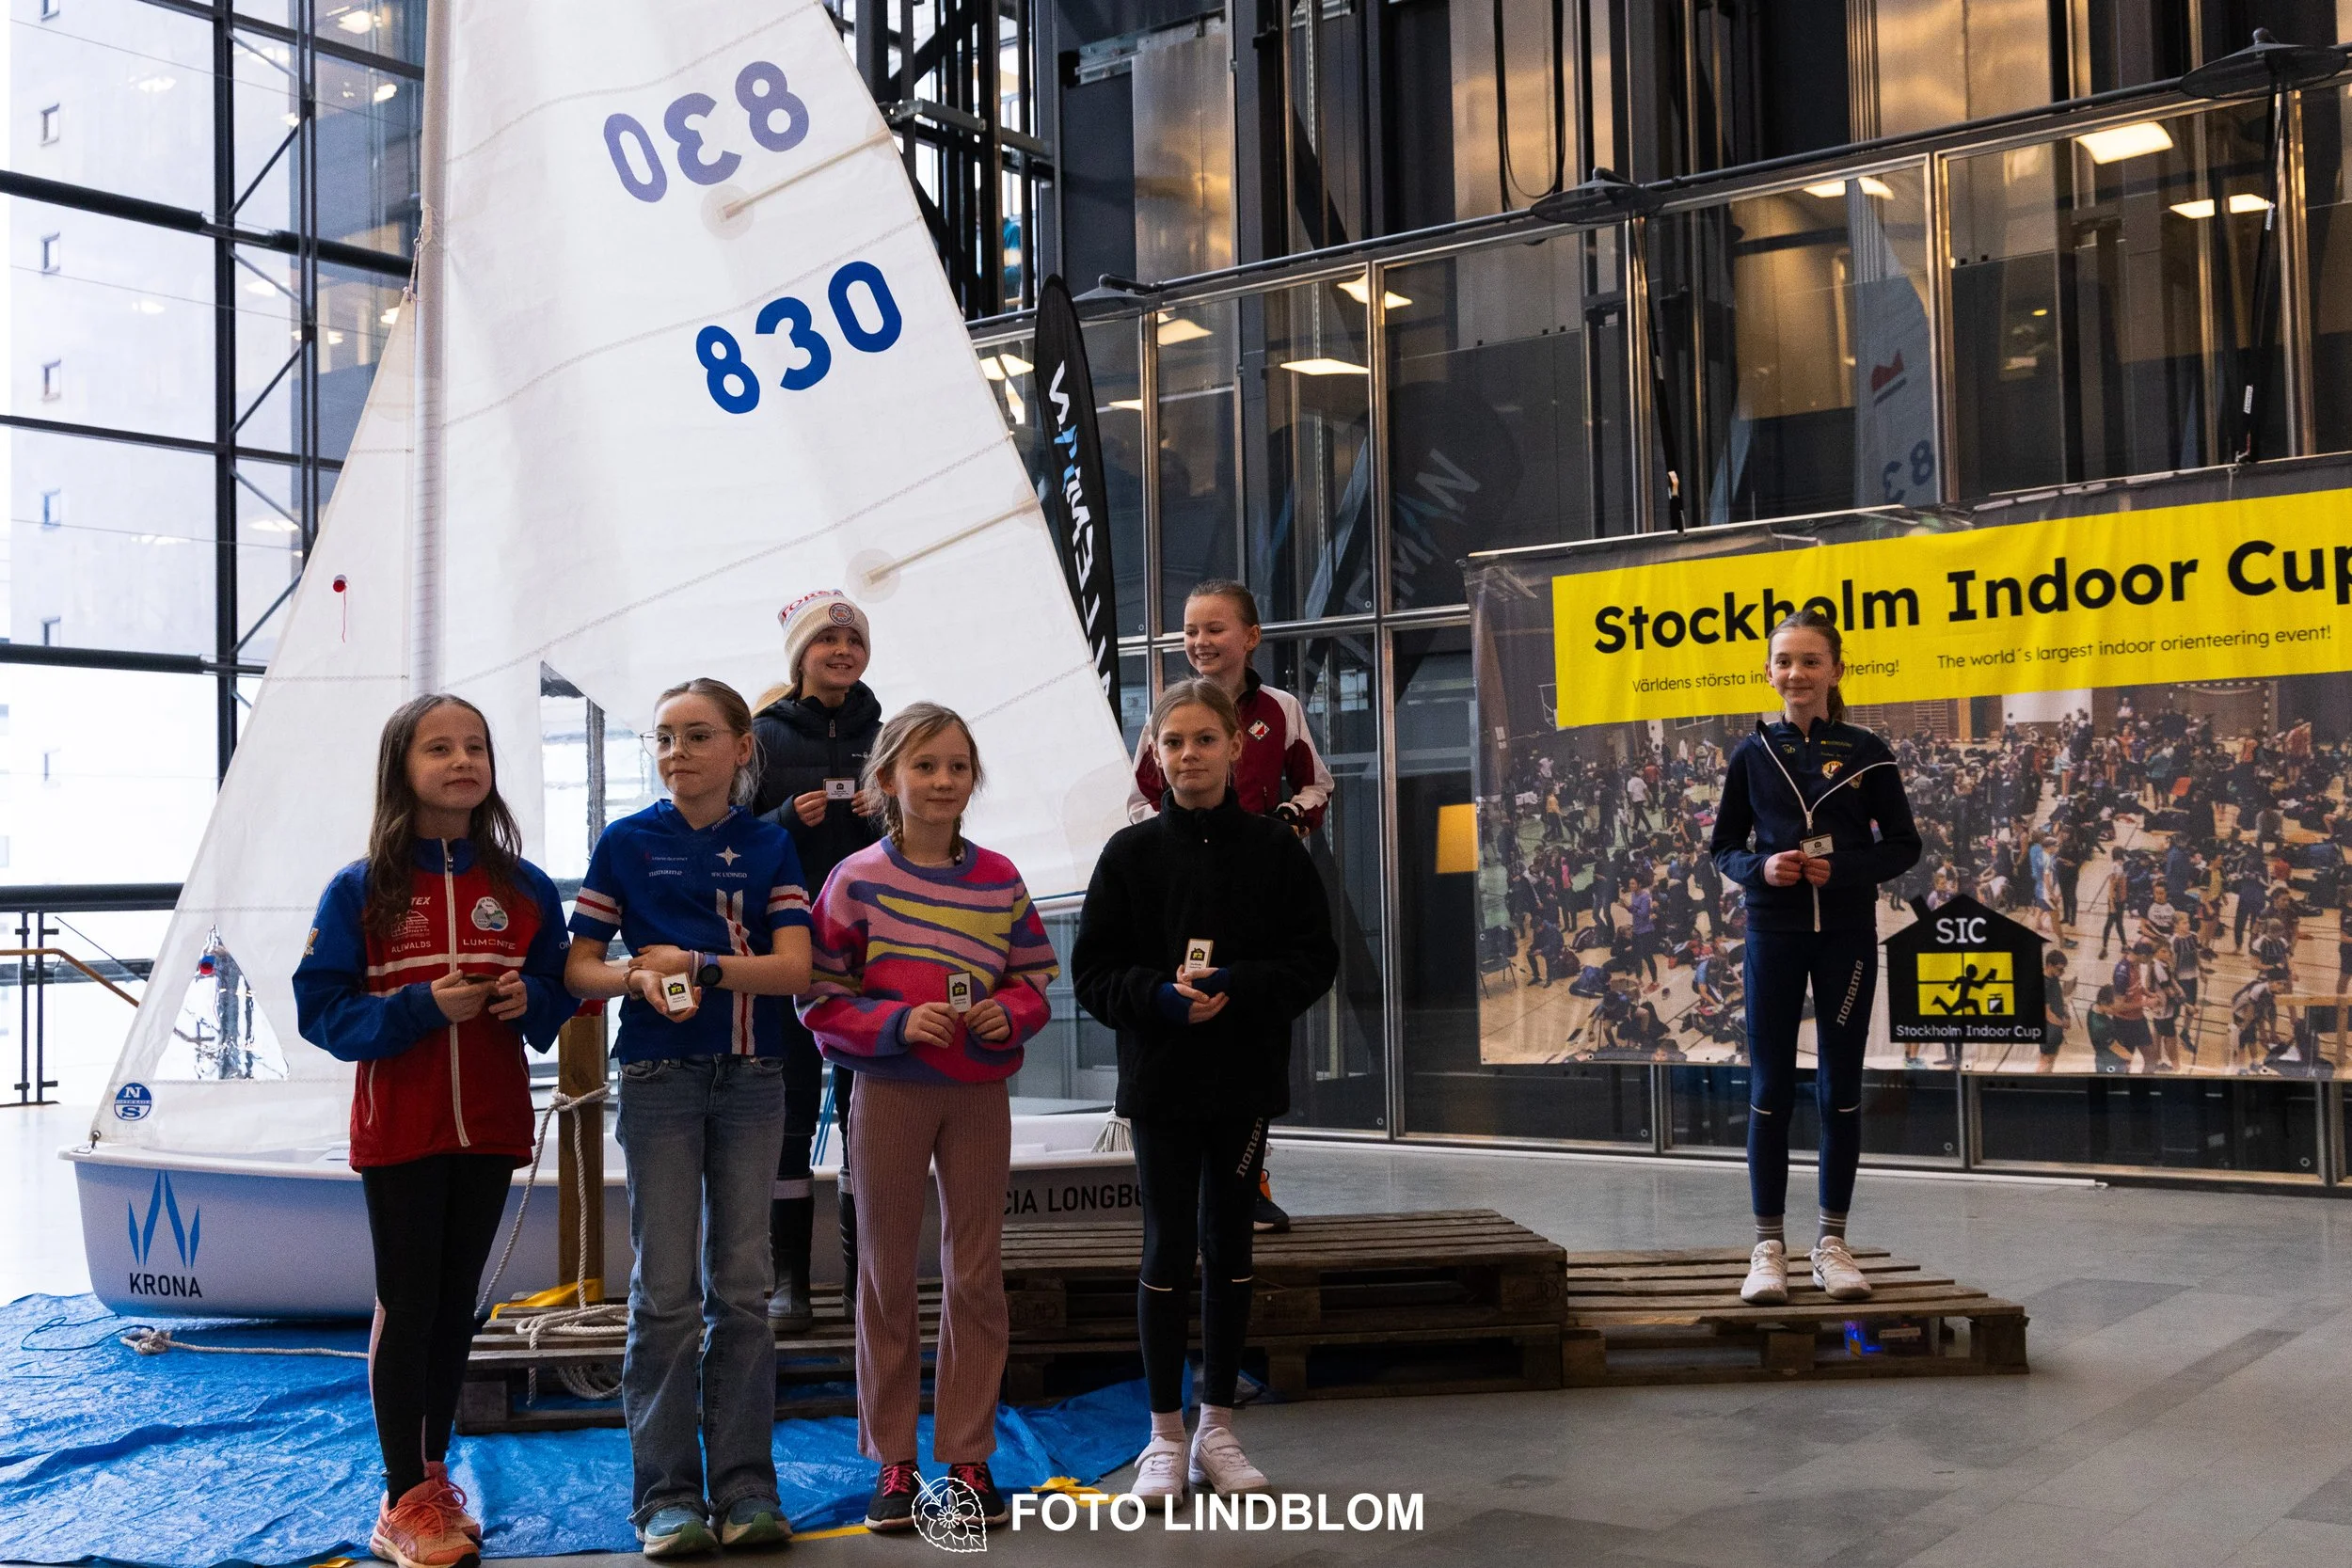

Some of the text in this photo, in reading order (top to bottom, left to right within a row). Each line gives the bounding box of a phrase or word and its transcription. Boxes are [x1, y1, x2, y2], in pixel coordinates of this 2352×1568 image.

[695, 261, 902, 415] 830
[1595, 578, 1919, 653] Stockholm
[1947, 557, 2199, 622] Indoor
[1937, 653, 1965, 669] The
[2036, 642, 2093, 662] largest
[2098, 638, 2155, 656] indoor
[2161, 629, 2269, 652] orienteering
[2275, 625, 2332, 643] event!
[1632, 674, 1692, 692] Världens
[1695, 673, 1746, 689] största
[1935, 917, 1987, 943] SIC
[1836, 959, 1864, 1027] noname
[1896, 1023, 2042, 1039] Stockholm Indoor Cup
[123, 1086, 142, 1099] N
[122, 1105, 140, 1117] S
[129, 1272, 202, 1298] KRONA
